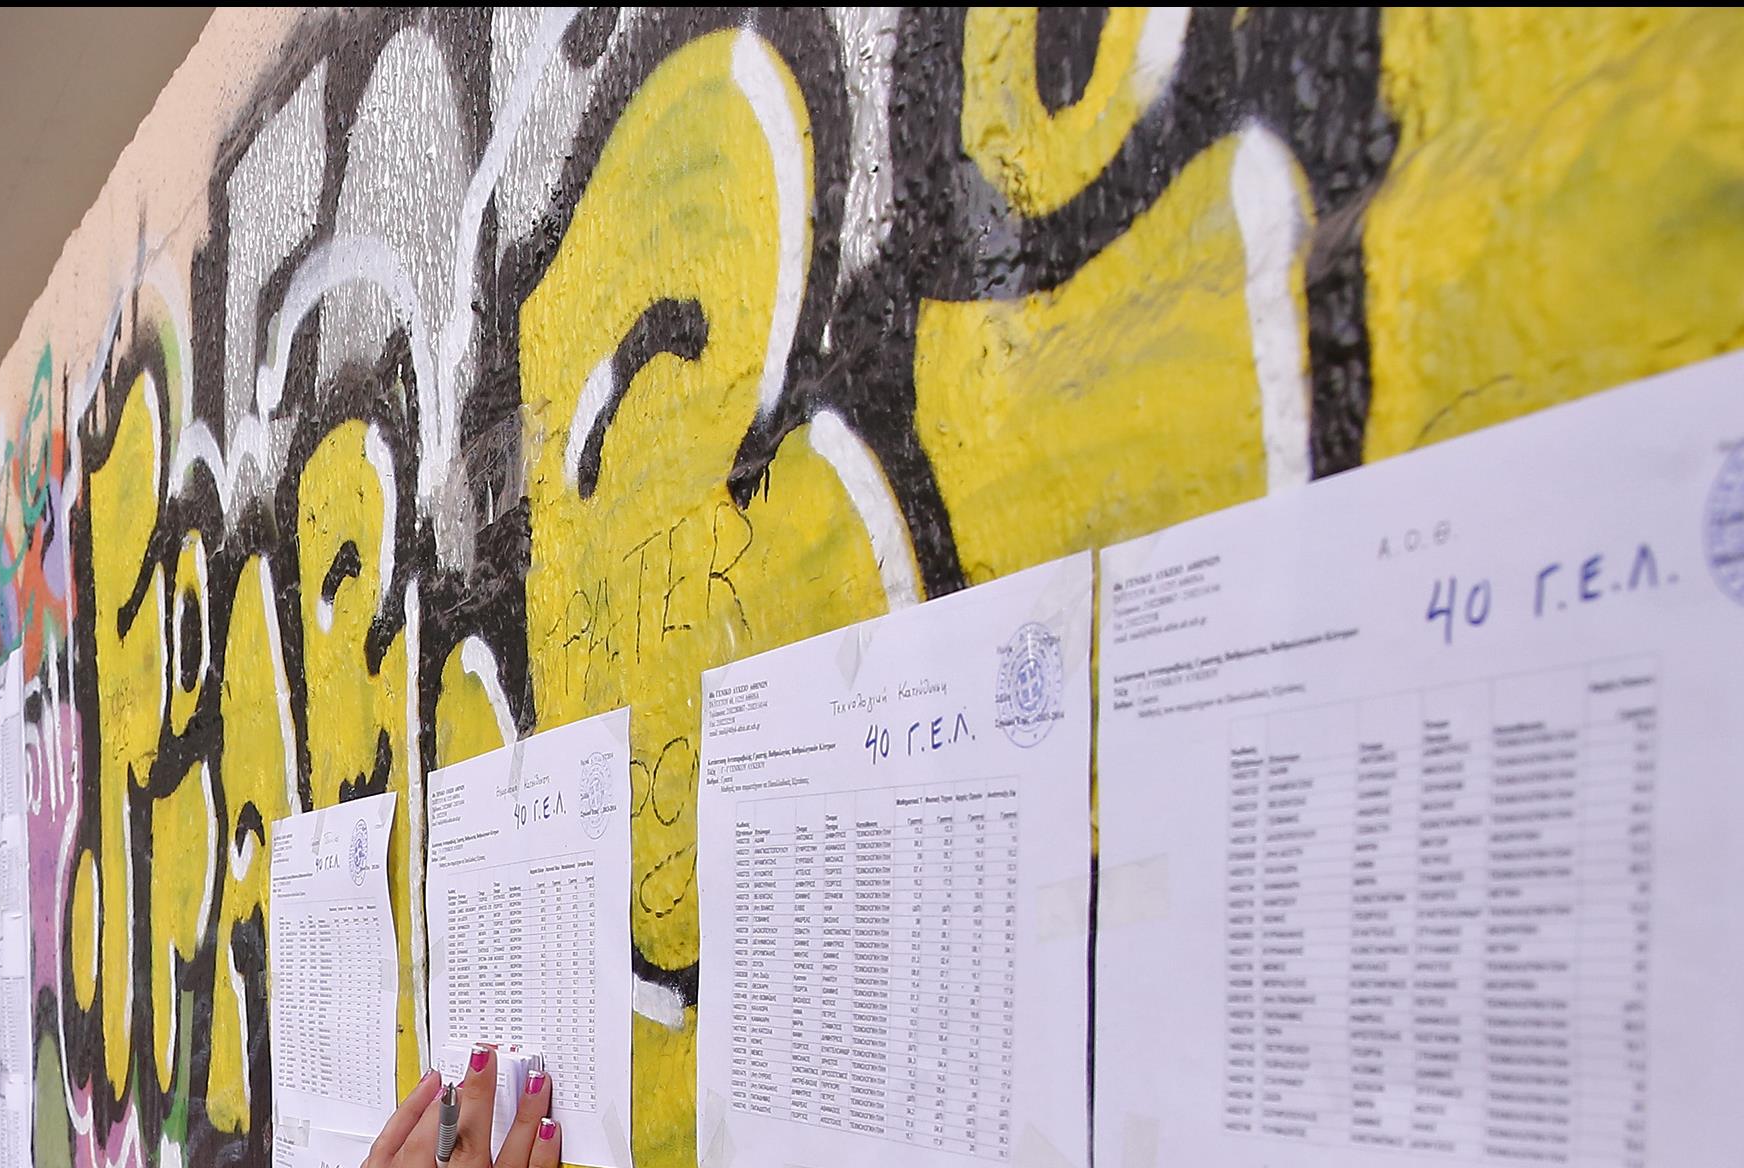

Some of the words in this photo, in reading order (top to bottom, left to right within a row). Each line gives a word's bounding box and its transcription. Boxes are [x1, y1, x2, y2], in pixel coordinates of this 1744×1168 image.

[1425, 575, 1493, 646] 40
[865, 724, 890, 766] 40
[514, 802, 527, 831] 40
